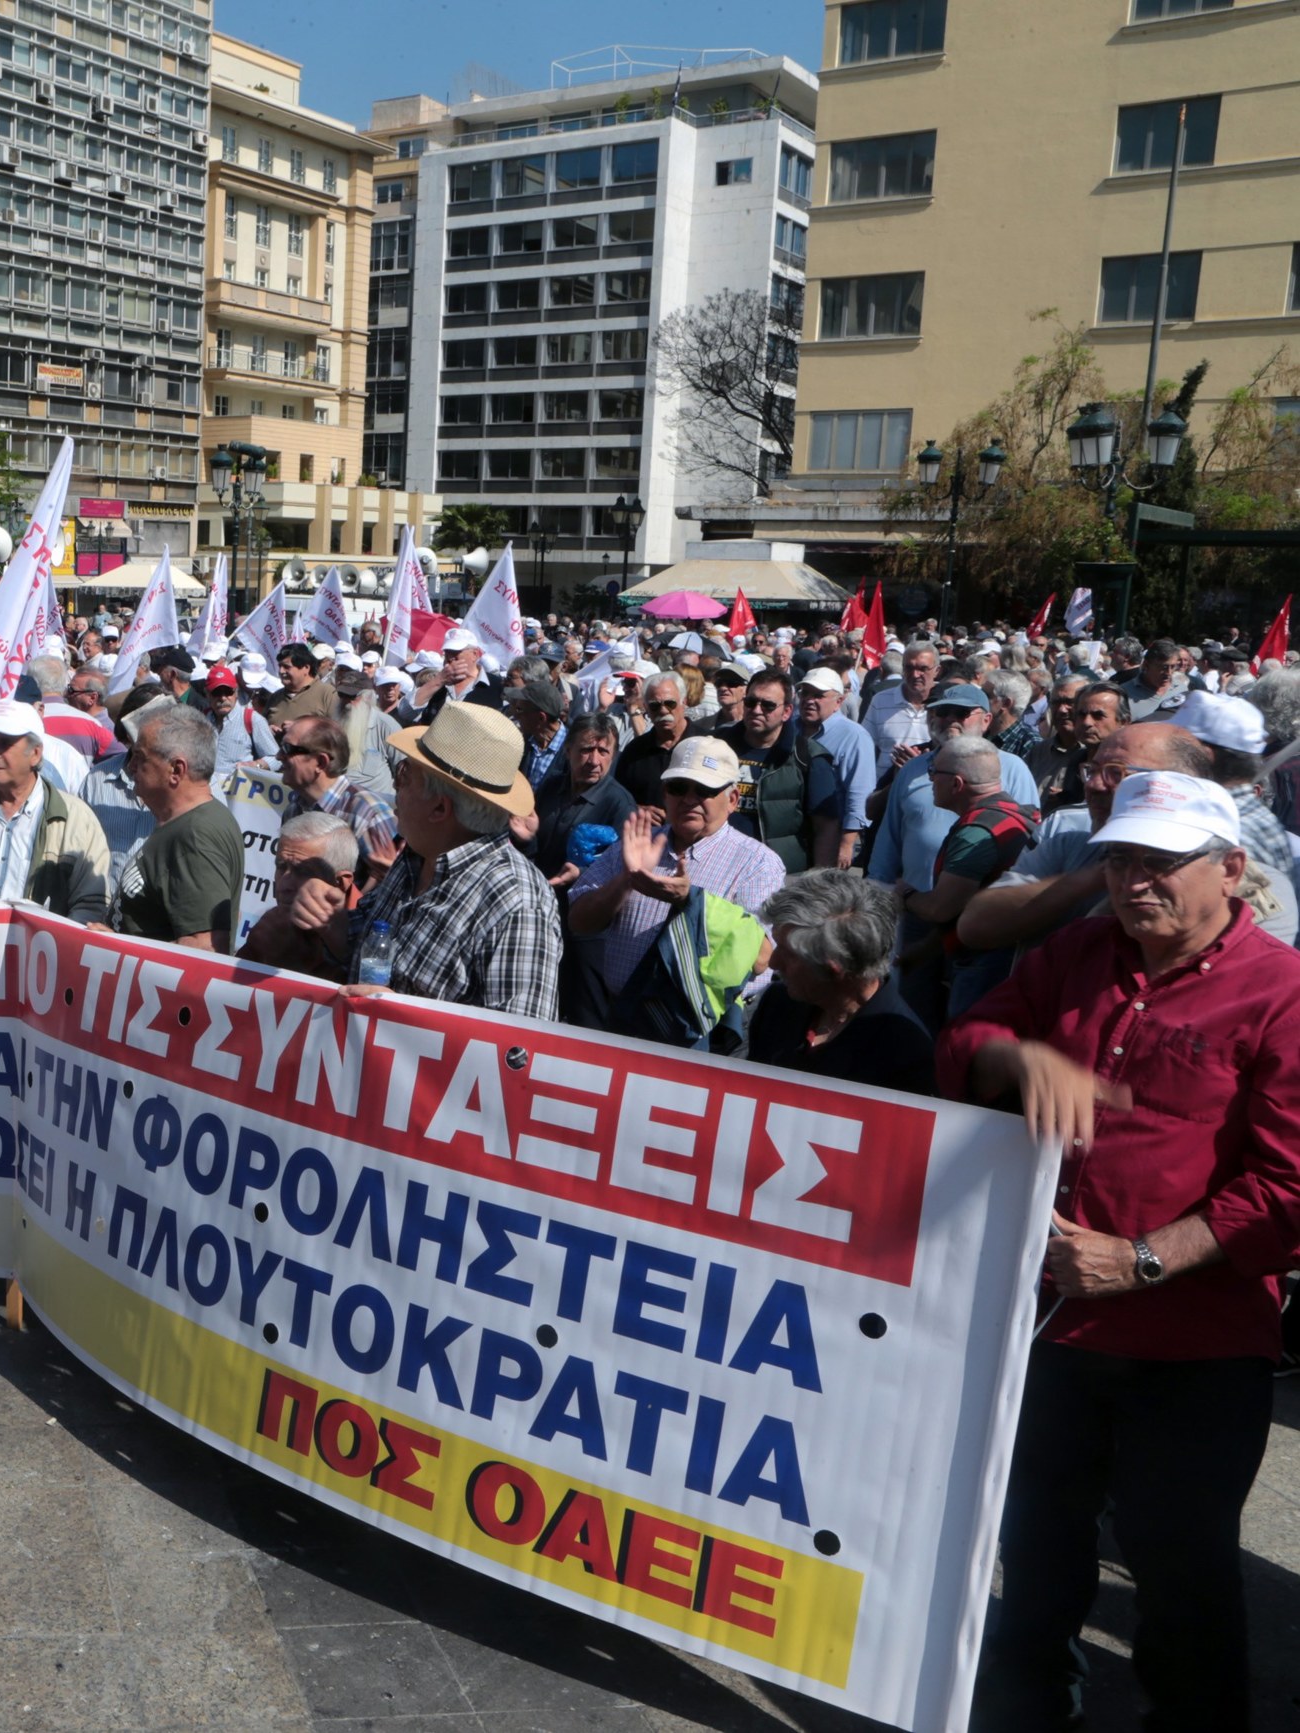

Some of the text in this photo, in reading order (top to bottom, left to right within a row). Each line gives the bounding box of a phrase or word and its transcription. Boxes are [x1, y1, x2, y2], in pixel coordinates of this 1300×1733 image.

[34, 1046, 118, 1152] ΤΗΝ
[132, 1094, 824, 1395] ΦΟΡΟΛΗΣΤΕΙΑ
[78, 943, 186, 1058] ΤΙΣ
[191, 979, 863, 1243] ΣΥΝΤΑΞΕΙΣ
[64, 1160, 97, 1242] Η
[107, 1184, 812, 1527] ΠΛΟΥΤΟΚΡΑΤΙΑ
[255, 1368, 785, 1639] ΠΟΣ ΟΑΕΕ
